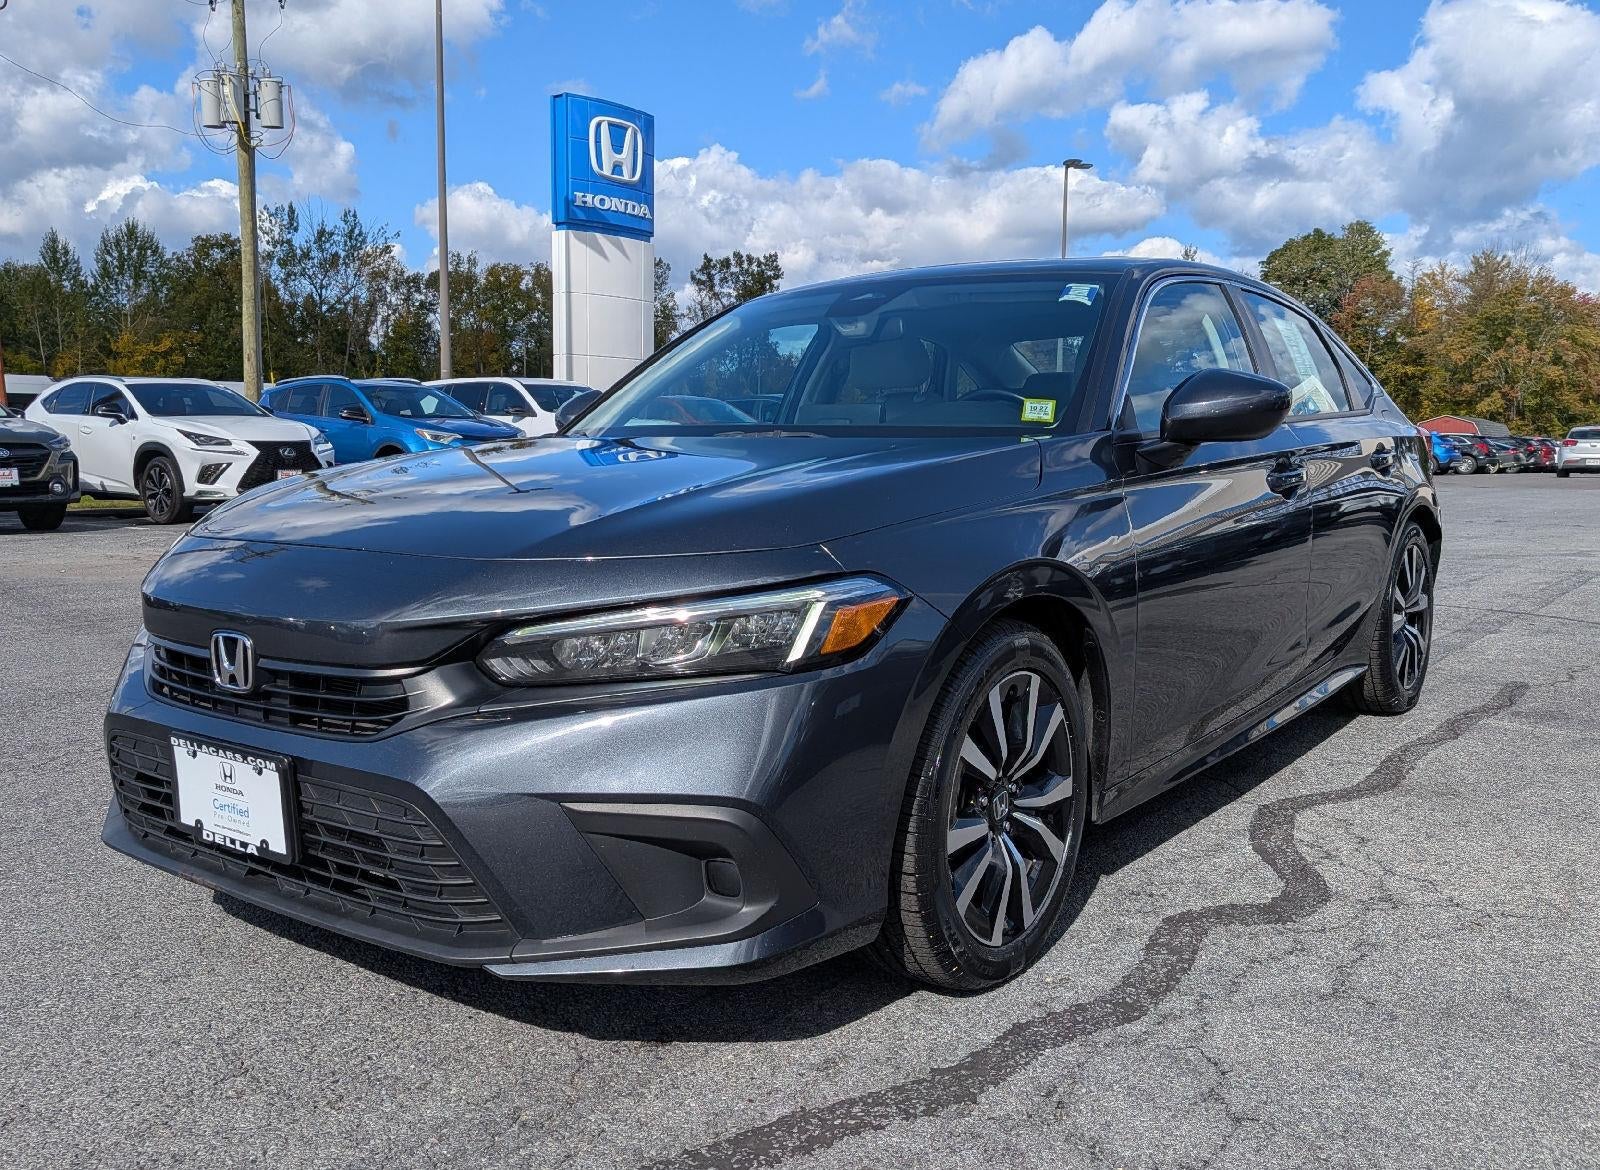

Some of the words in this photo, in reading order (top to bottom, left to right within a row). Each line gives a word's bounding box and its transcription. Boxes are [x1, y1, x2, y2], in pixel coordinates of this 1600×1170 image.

[574, 192, 652, 219] HONDA
[170, 736, 276, 771] DELLACARS.COM
[214, 783, 245, 797] HONDA
[213, 798, 250, 818] Certified
[202, 830, 260, 856] DELLA
